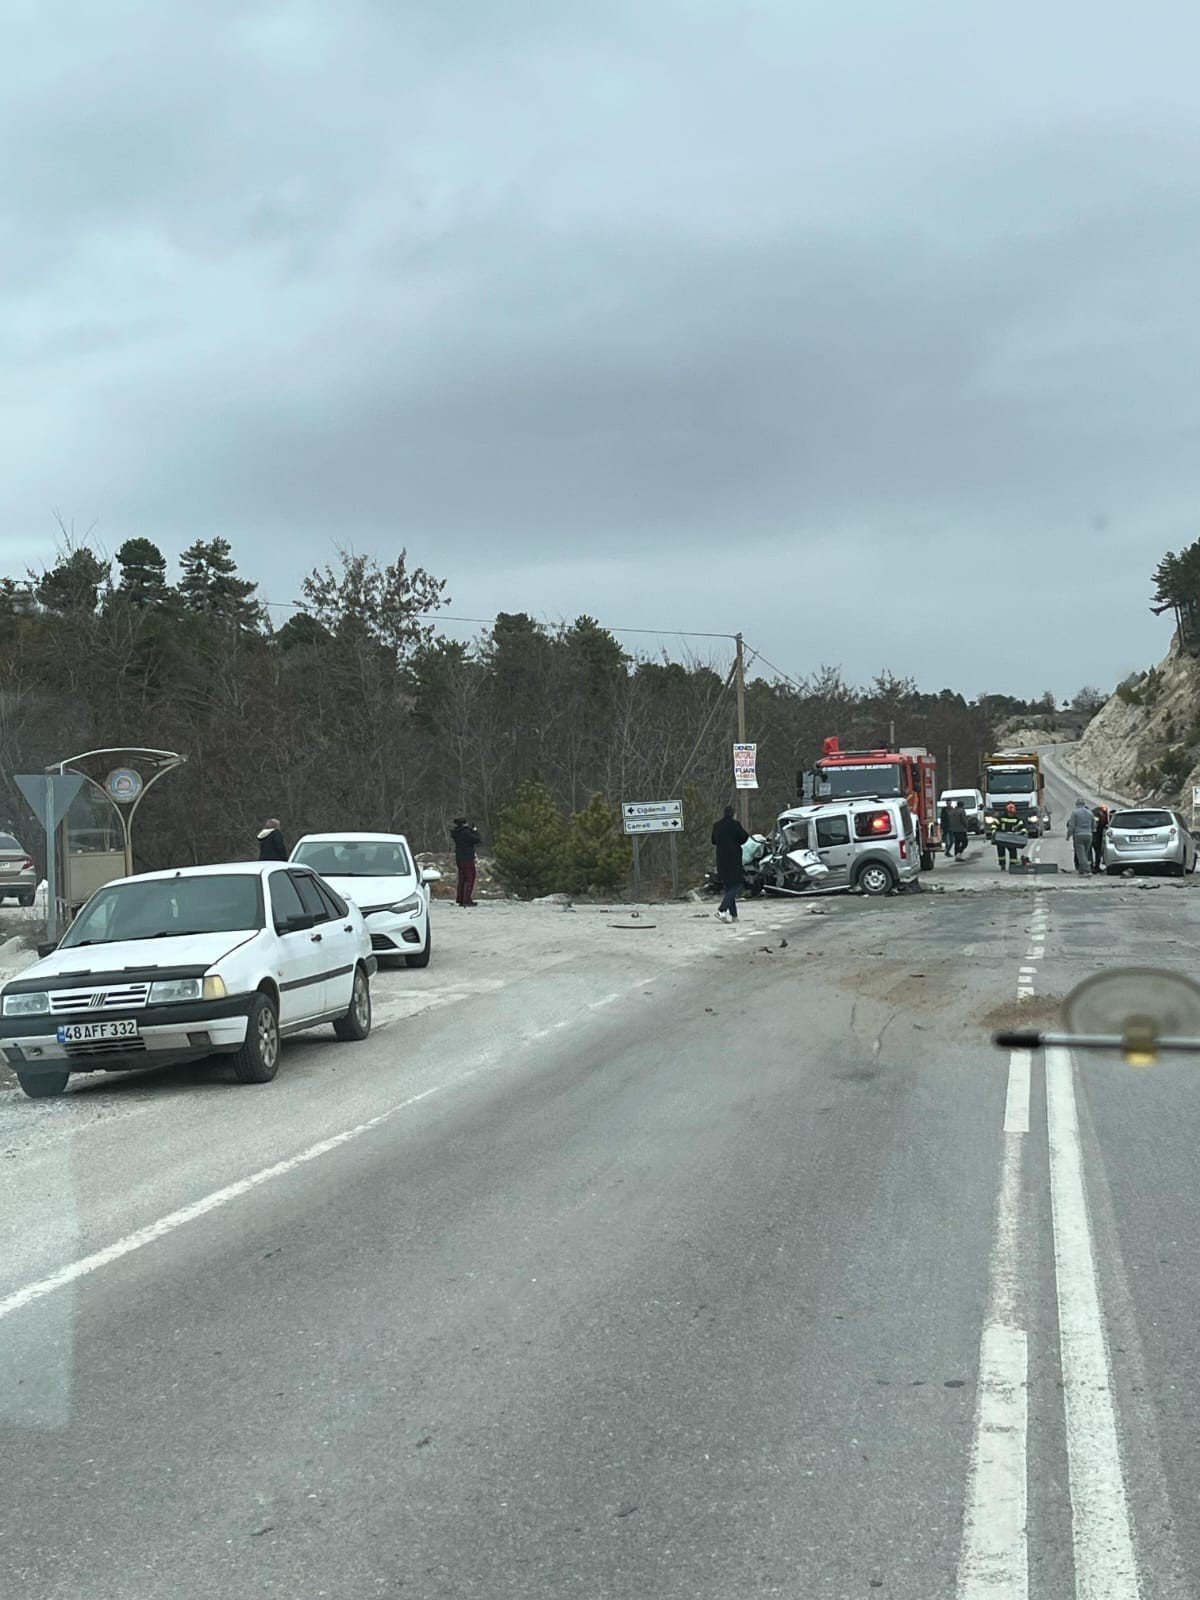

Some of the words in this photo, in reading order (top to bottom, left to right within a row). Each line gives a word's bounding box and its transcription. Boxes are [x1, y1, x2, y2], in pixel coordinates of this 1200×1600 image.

[65, 1026, 82, 1040] 48
[84, 1024, 108, 1039] AFF
[110, 1022, 135, 1036] 332
